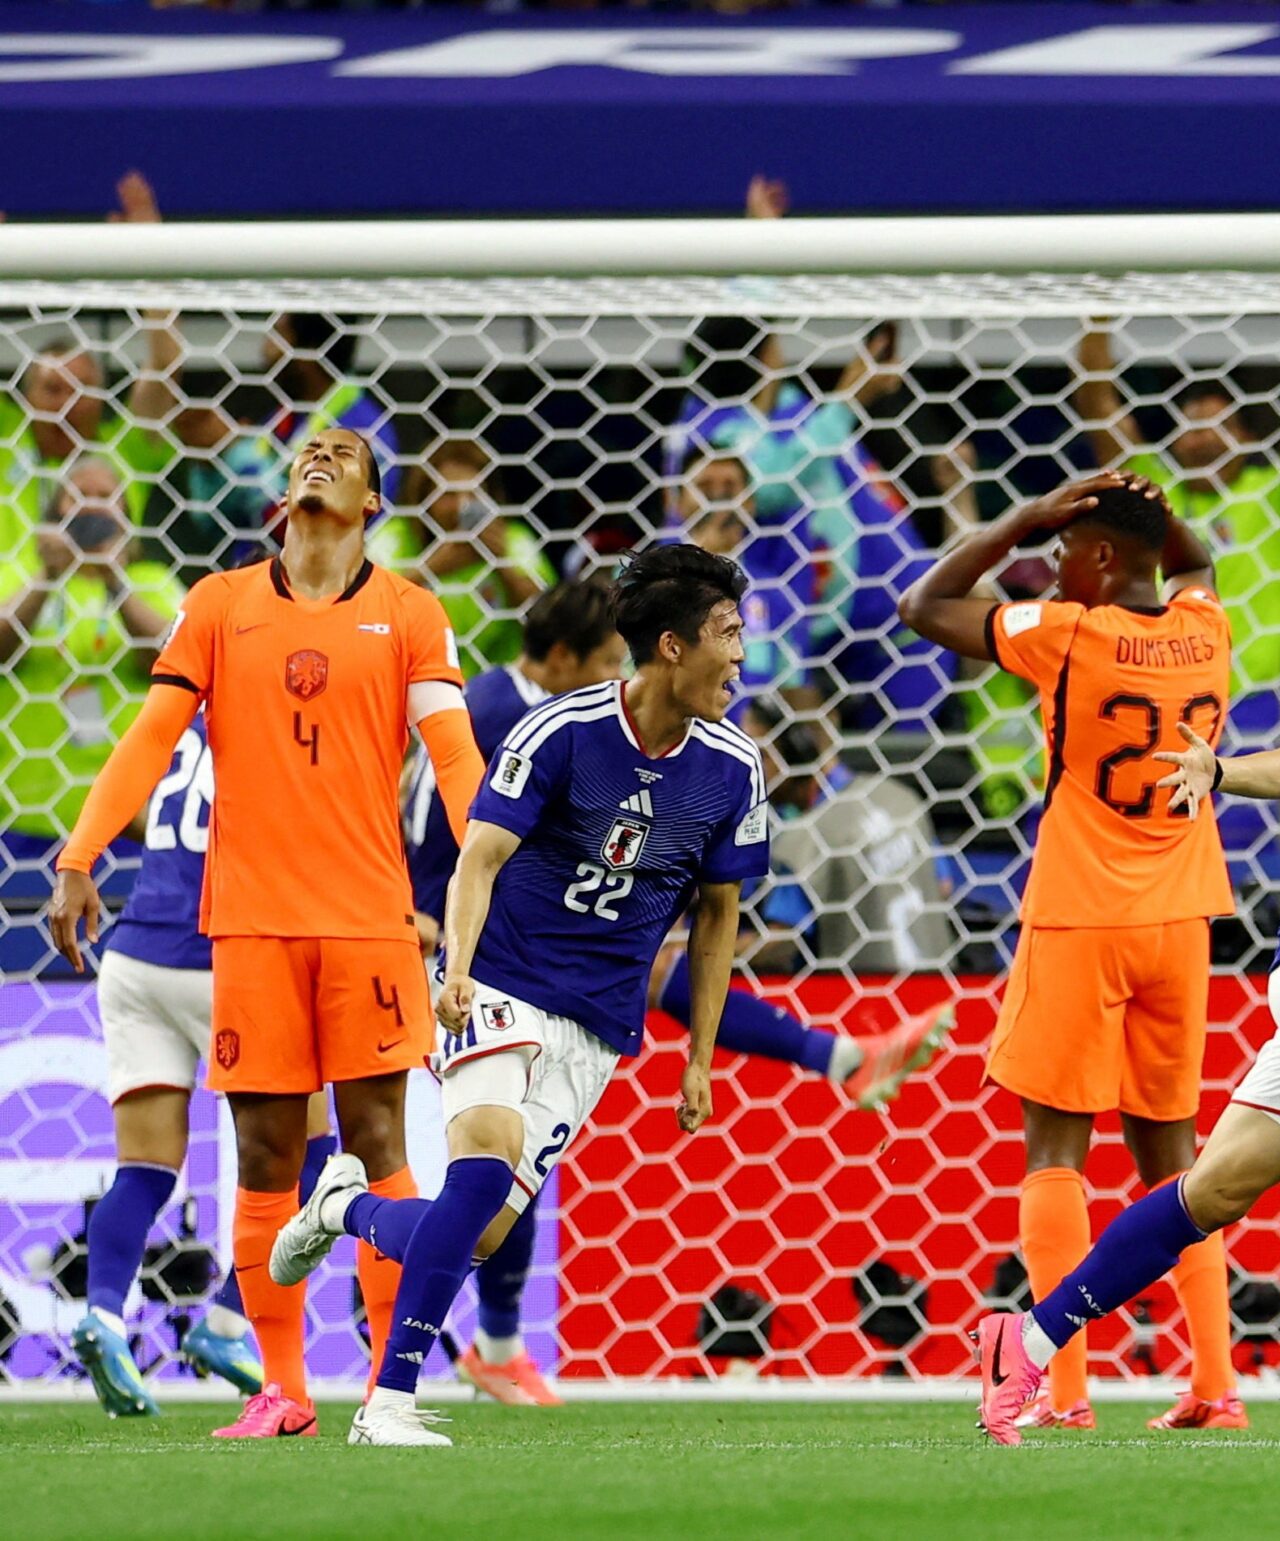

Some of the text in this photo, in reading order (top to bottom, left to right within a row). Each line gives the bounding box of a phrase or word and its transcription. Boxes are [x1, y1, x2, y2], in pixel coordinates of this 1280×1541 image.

[1115, 635, 1215, 668] DUMFRIES
[293, 710, 319, 766] 4
[563, 860, 635, 922] 22
[371, 974, 405, 1028] 4
